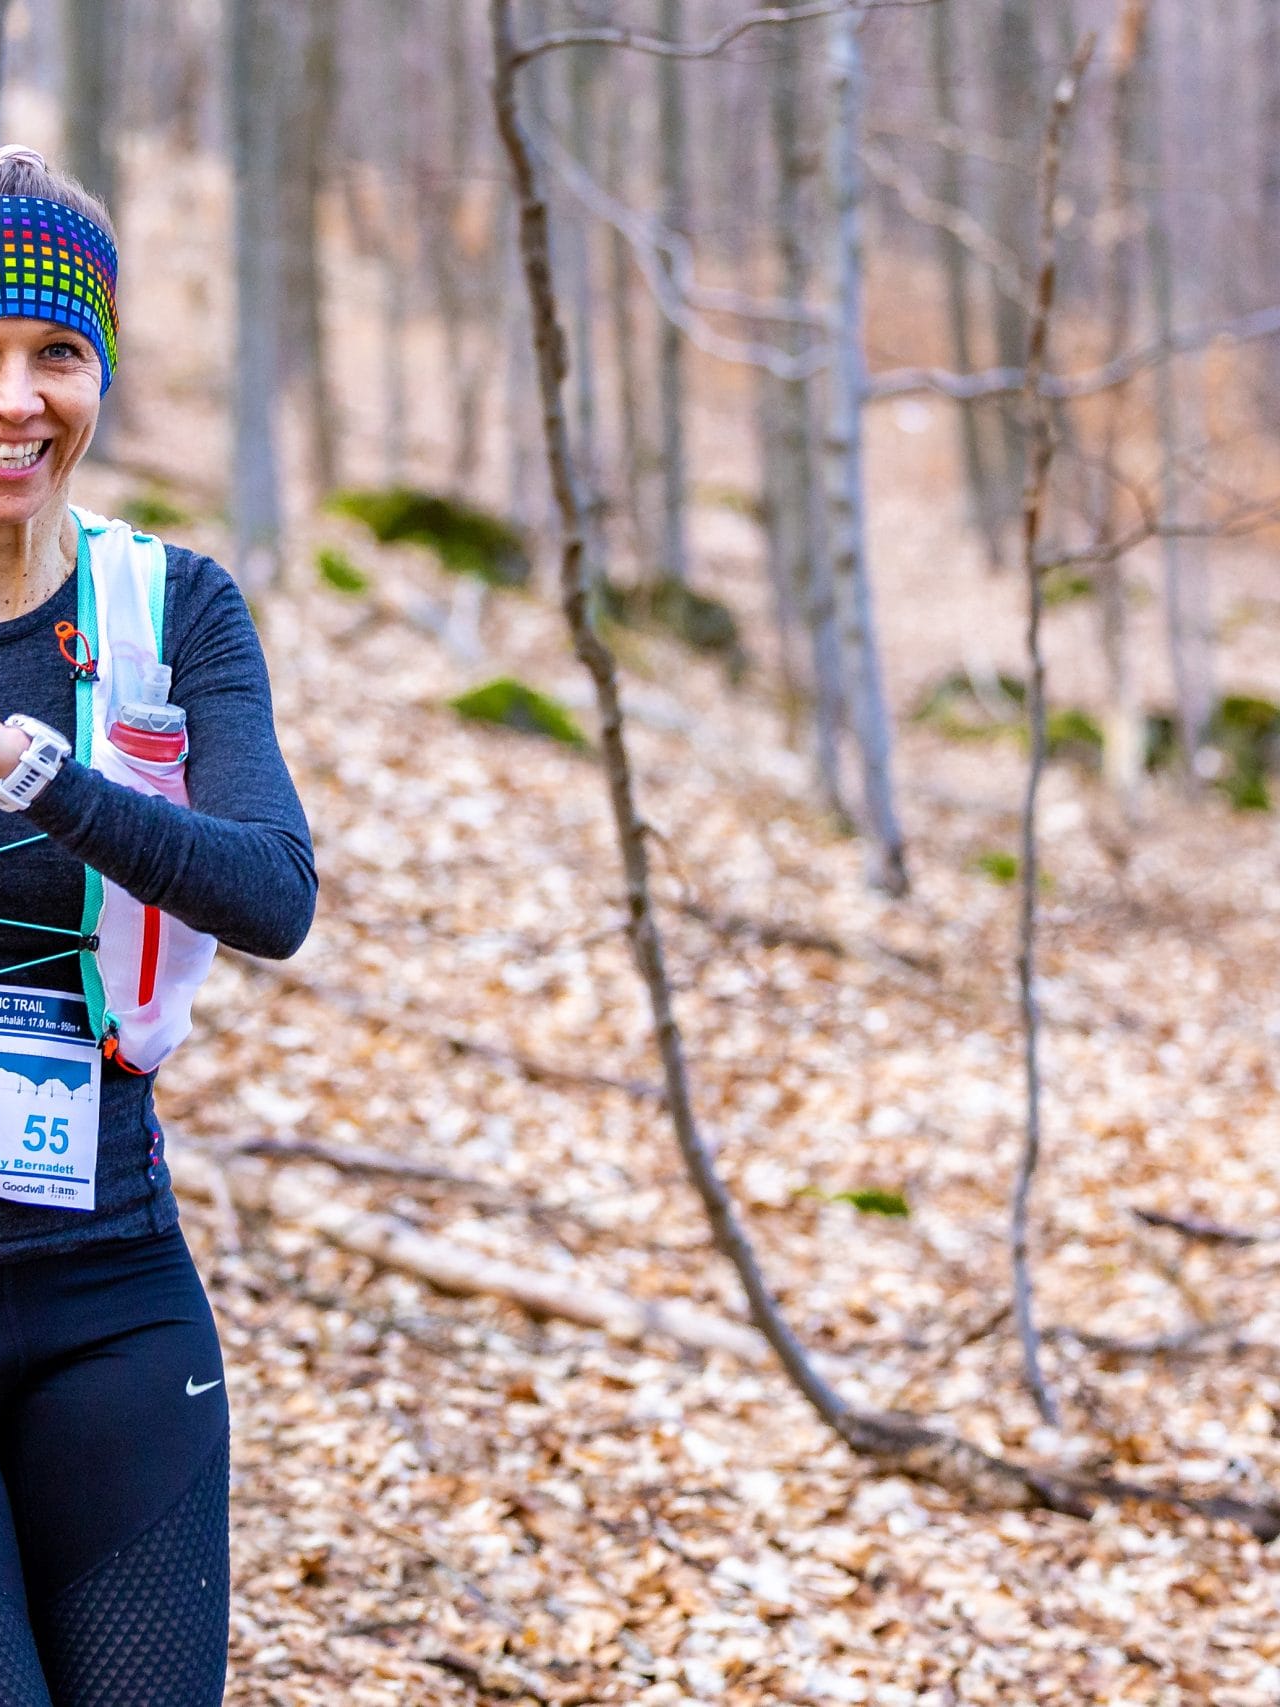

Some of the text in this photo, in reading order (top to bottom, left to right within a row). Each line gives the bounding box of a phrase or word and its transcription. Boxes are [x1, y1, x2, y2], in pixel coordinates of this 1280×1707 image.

[13, 998, 46, 1014] TRAIL
[28, 1017, 44, 1028] 17.0
[45, 1019, 56, 1029] km
[22, 1114, 69, 1154] 55
[13, 1158, 74, 1175] Bernadett
[2, 1181, 45, 1194] Goodwill
